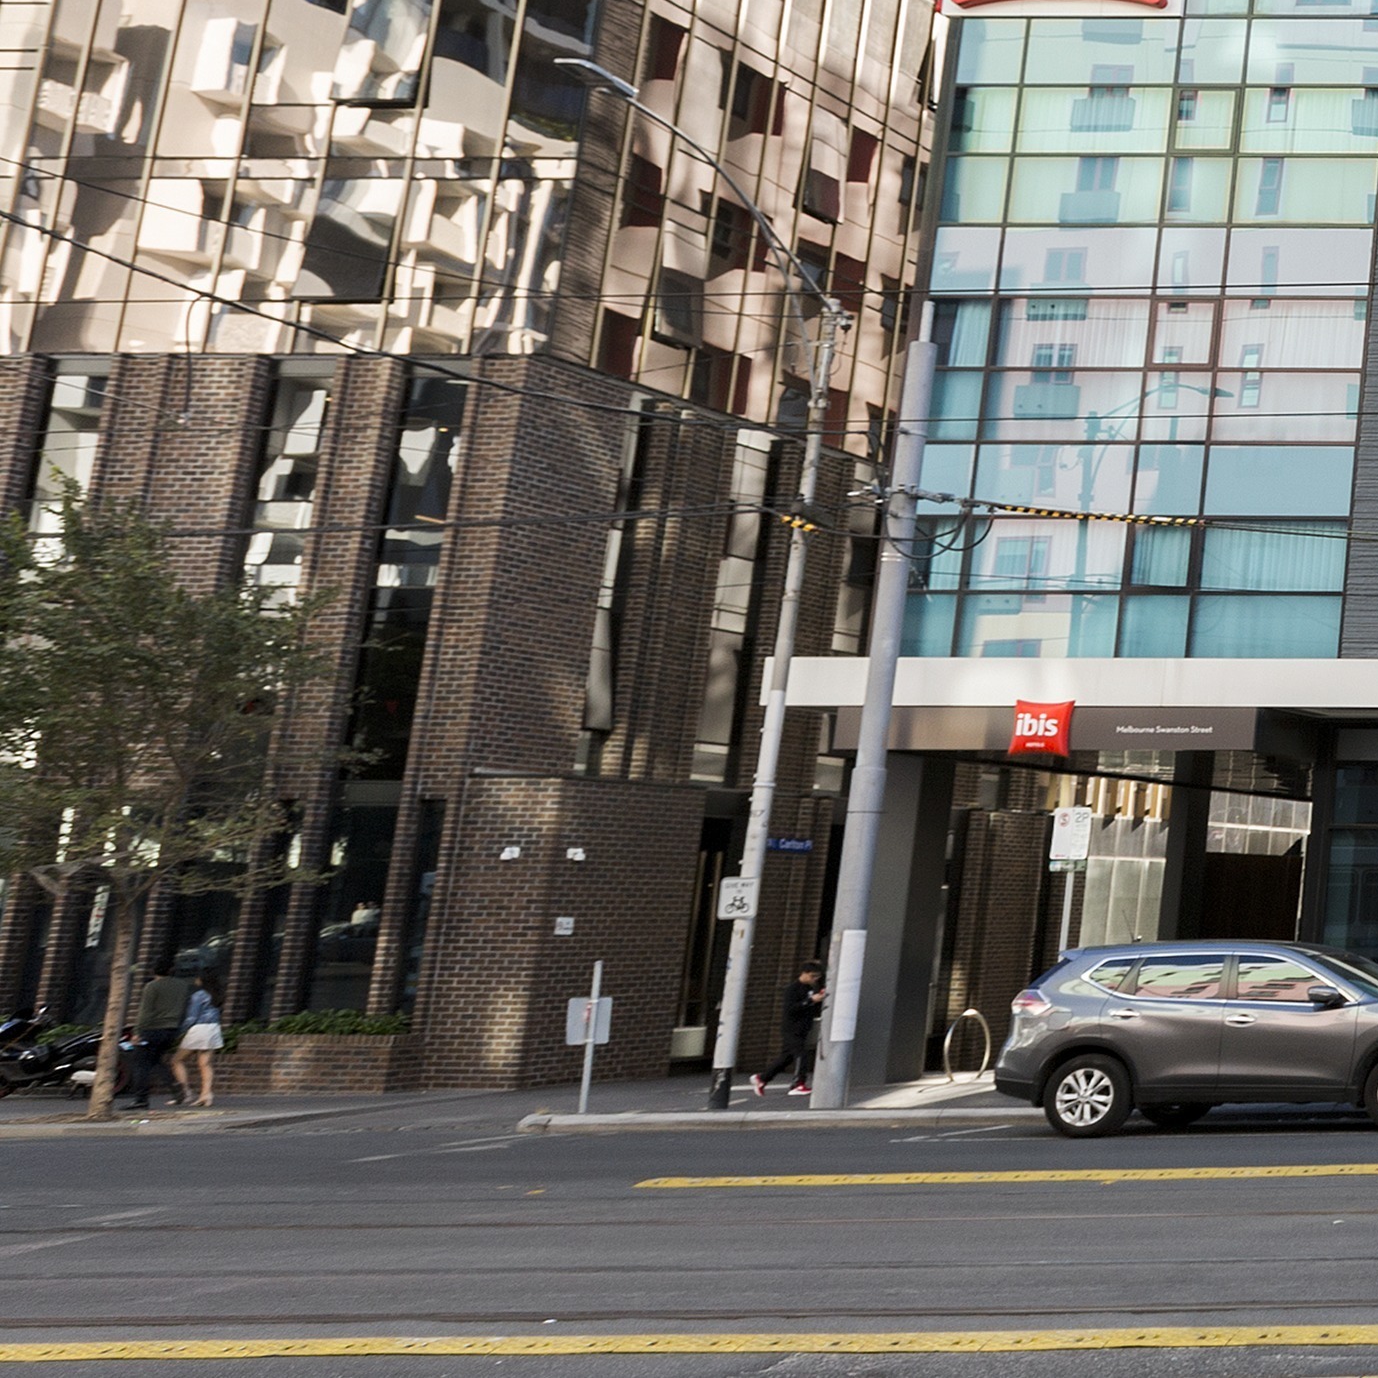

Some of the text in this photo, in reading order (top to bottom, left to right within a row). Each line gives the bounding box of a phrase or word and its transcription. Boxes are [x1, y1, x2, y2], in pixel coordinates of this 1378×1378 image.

[1015, 712, 1059, 737] ibis
[1116, 725, 1213, 734] Melbourne Swanston Street
